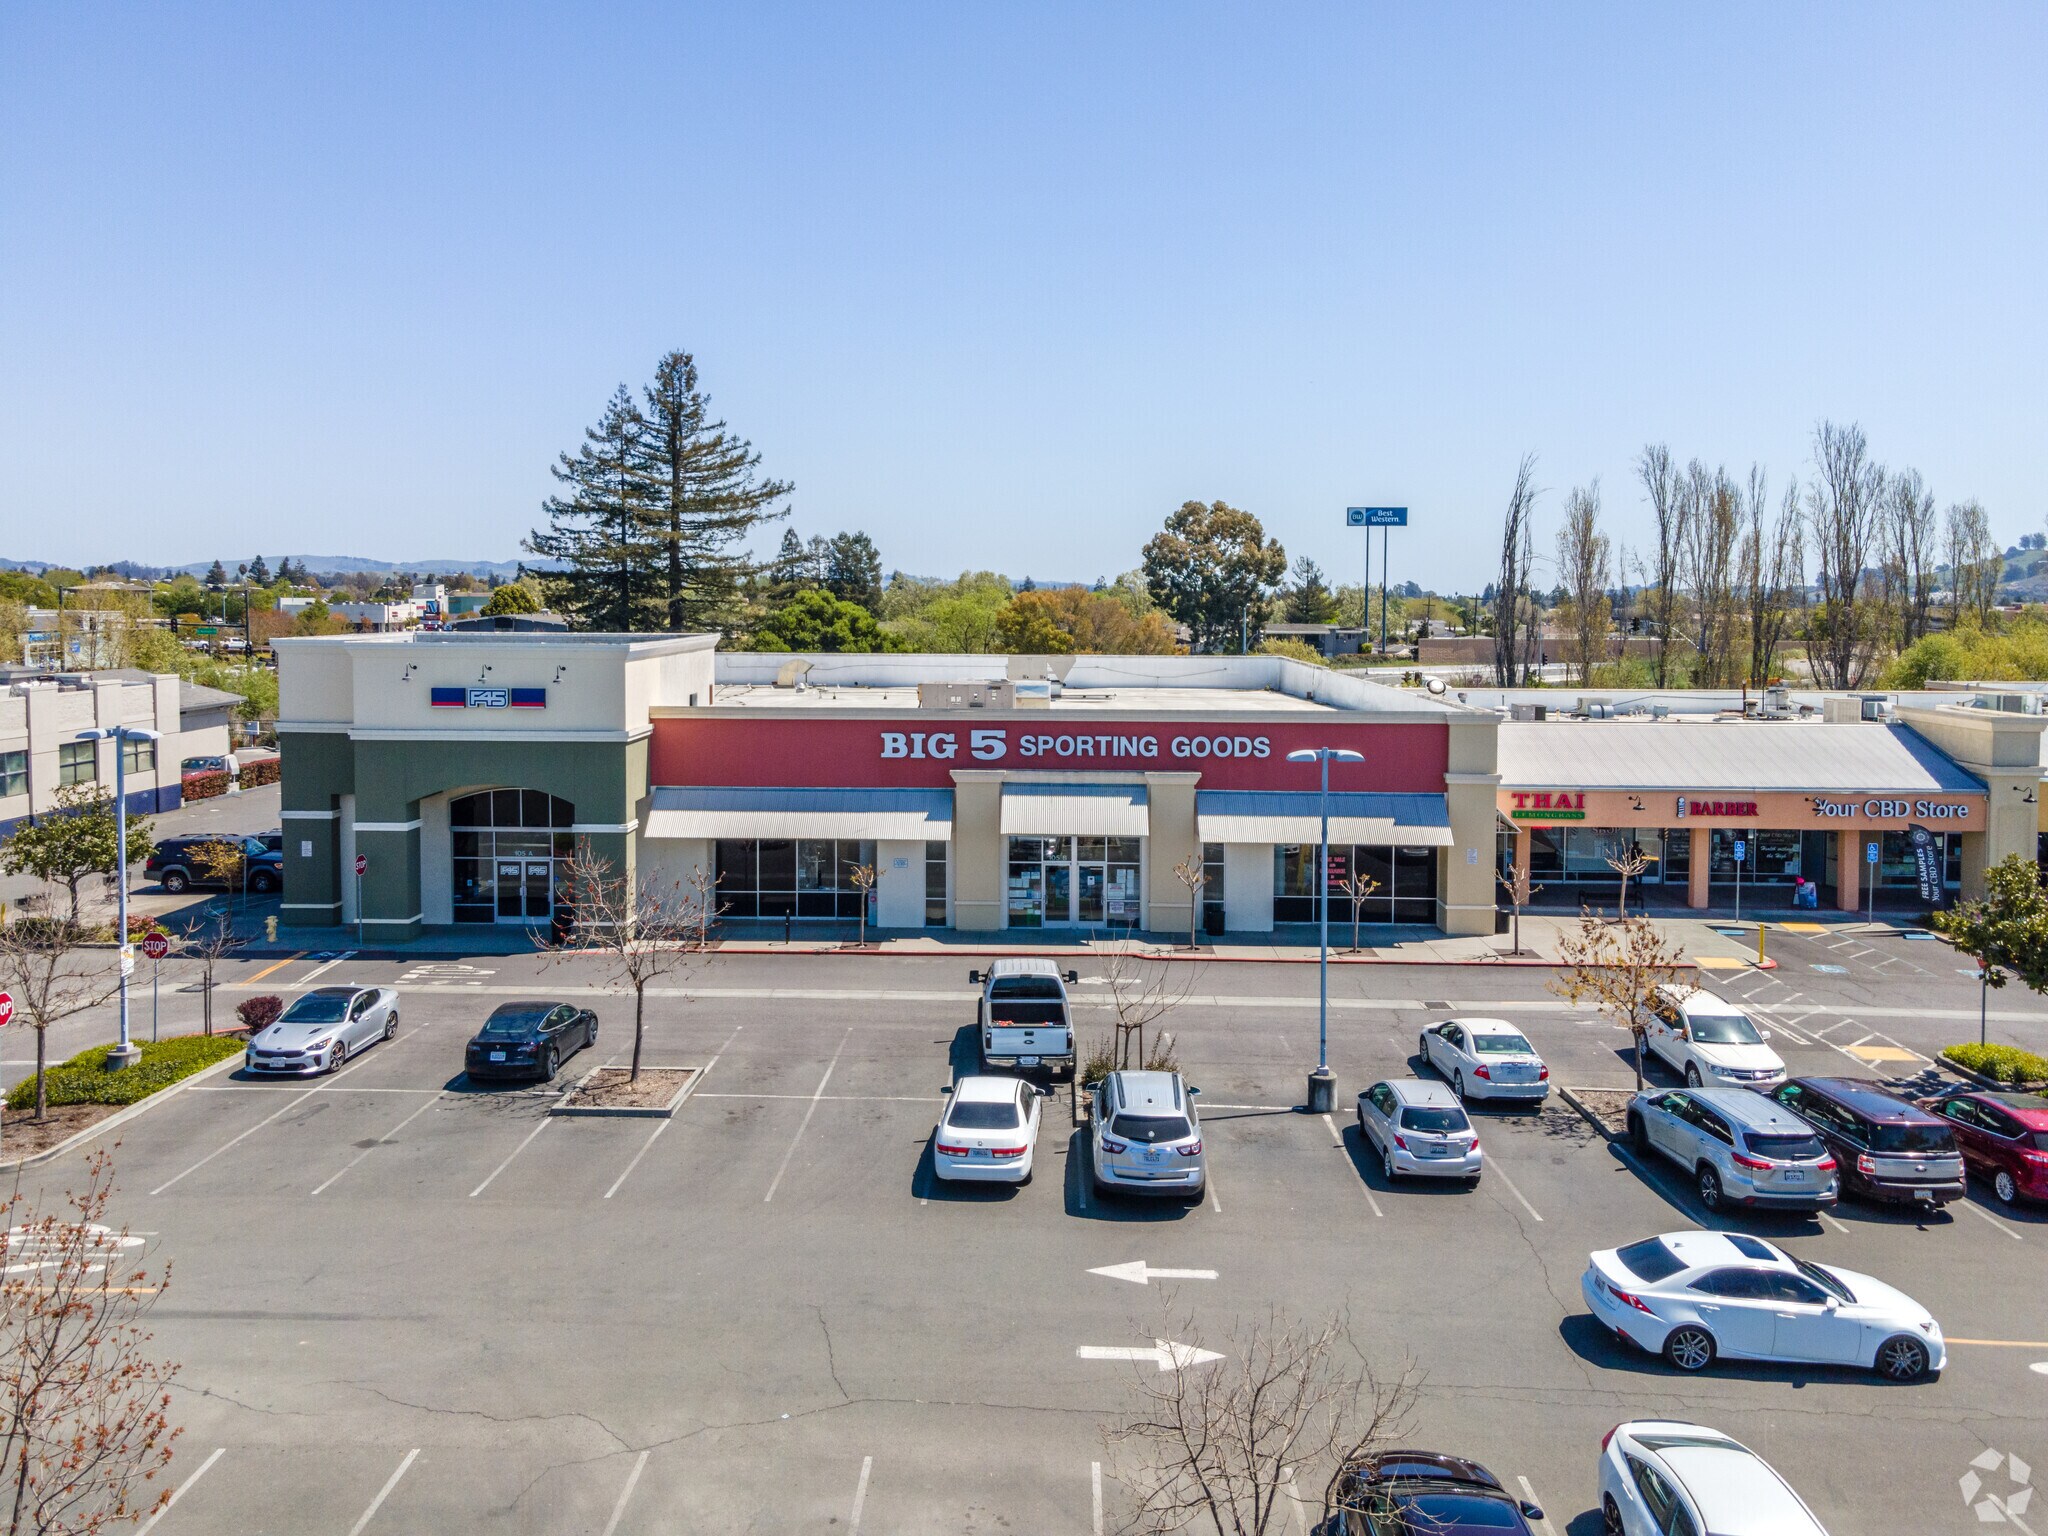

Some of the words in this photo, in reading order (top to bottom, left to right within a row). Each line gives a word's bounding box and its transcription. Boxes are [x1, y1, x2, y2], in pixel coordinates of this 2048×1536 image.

[469, 689, 508, 708] F45
[880, 733, 958, 759] BIG
[970, 730, 1007, 760] 5
[1019, 735, 1158, 757] SPORTING
[1171, 736, 1271, 758] GOODS
[1511, 793, 1585, 809] THAI
[1690, 801, 1759, 816] BARBER
[1815, 799, 1859, 817] Your
[1864, 799, 1911, 818] CBD
[1915, 799, 1969, 818] Store
[1926, 845, 1936, 866] Store
[500, 866, 520, 876] F45
[528, 866, 548, 876] F45
[1916, 848, 1928, 882] SAMPLES
[1928, 866, 1938, 885] CBD
[1921, 882, 1930, 899] FREE
[1931, 886, 1940, 902] Your
[144, 940, 167, 951] STOP
